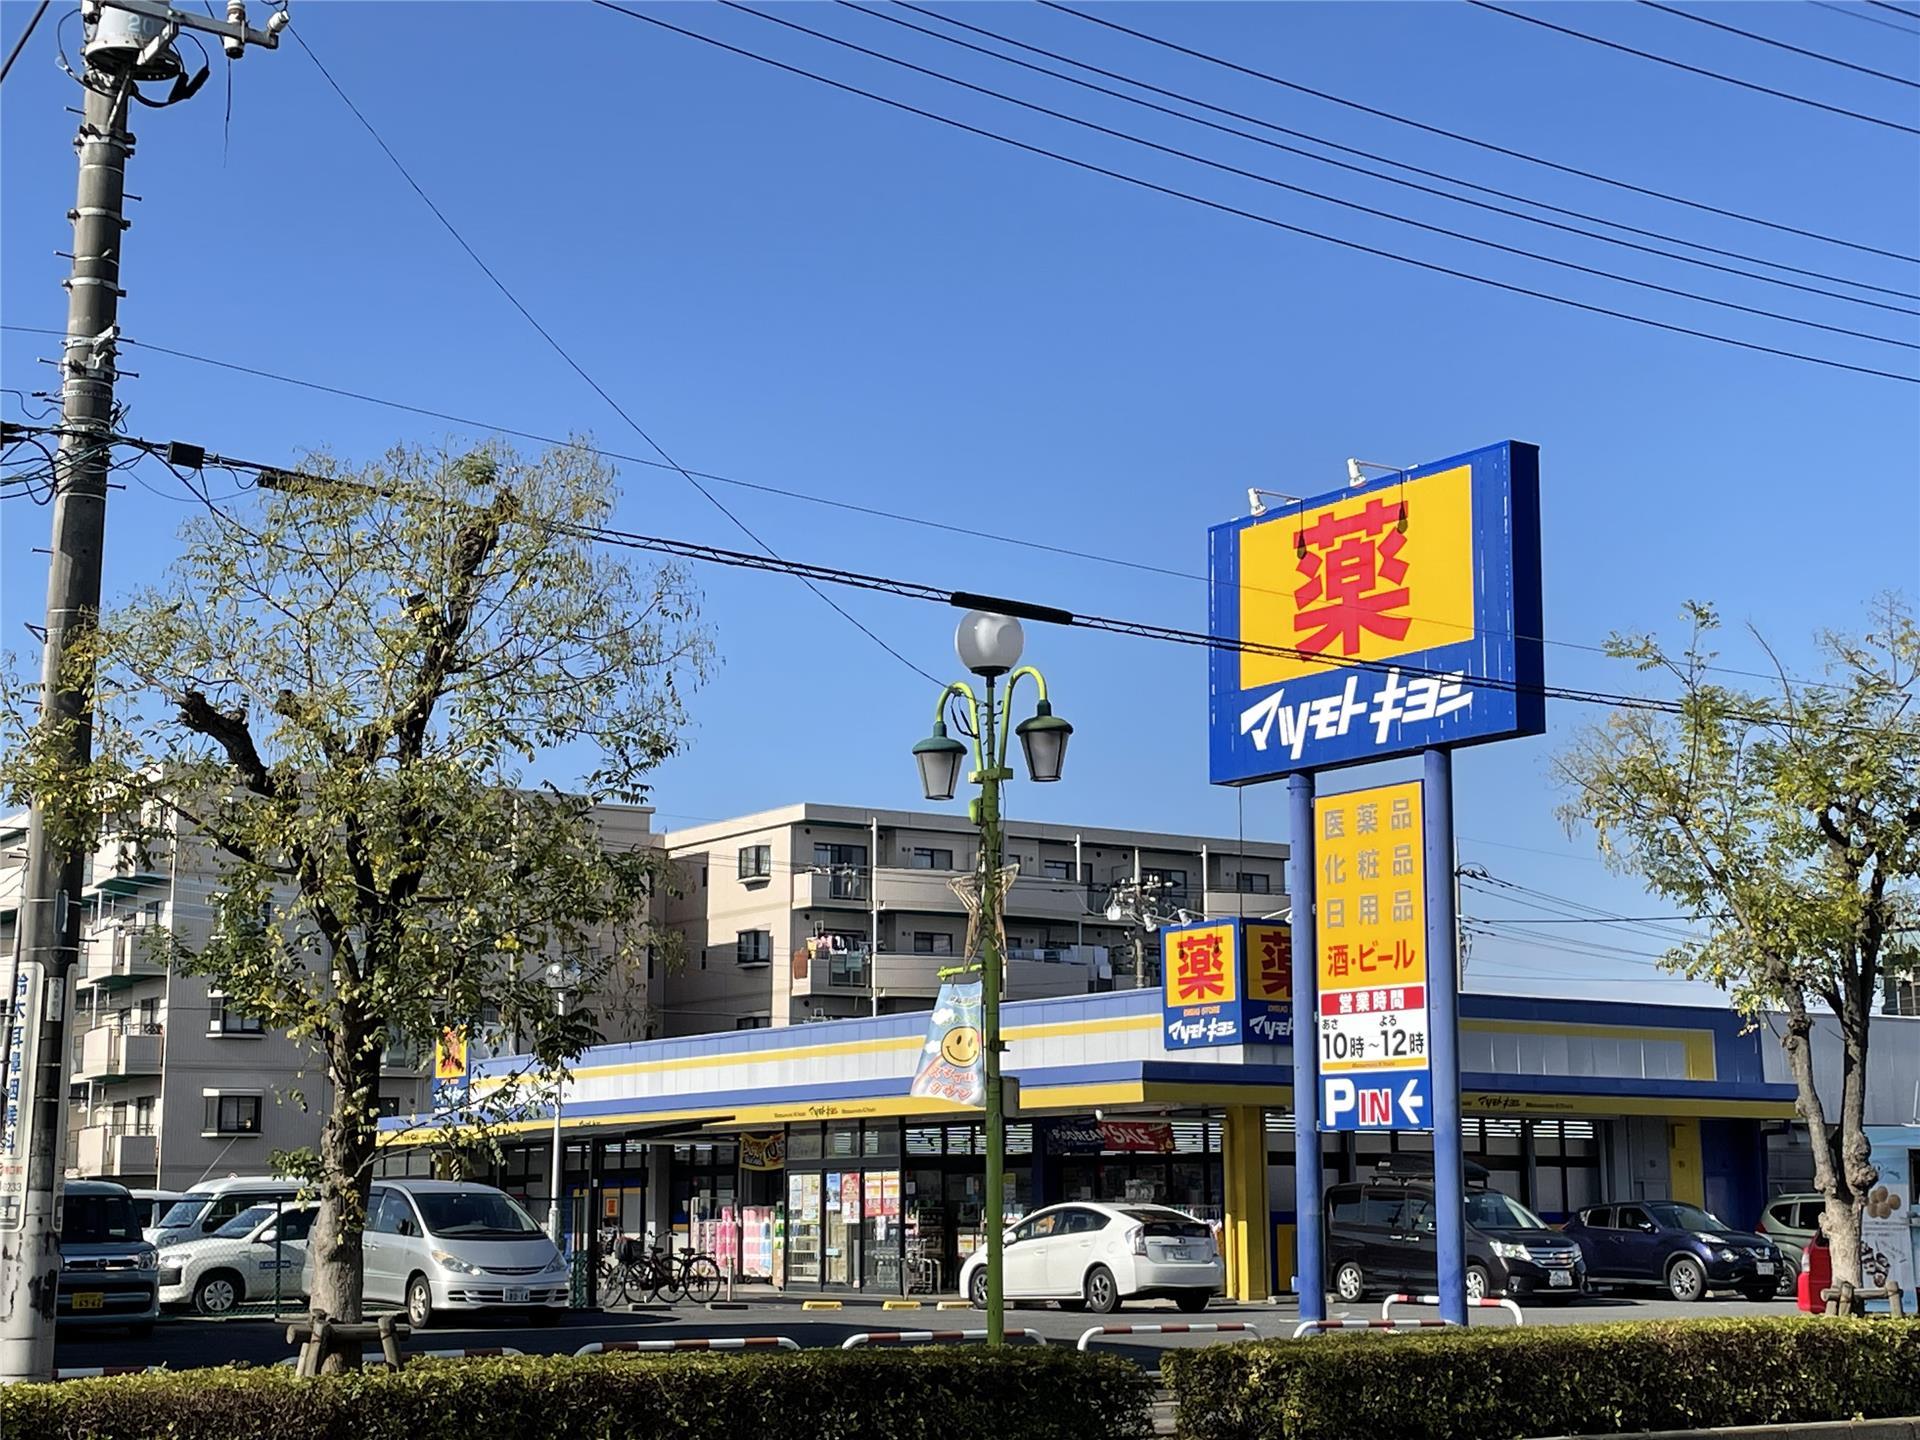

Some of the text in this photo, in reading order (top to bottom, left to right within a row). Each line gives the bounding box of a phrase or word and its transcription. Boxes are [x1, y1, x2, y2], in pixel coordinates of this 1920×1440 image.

[1293, 499, 1412, 661] 薬
[1240, 667, 1474, 760] マツモトキヨシ
[1324, 798, 1412, 841] 医薬品
[1325, 844, 1414, 885] 化粧品
[1326, 889, 1414, 929] 日用品
[1177, 933, 1225, 1000] 薬
[1322, 1015, 1397, 1030] あさ よる
[1339, 989, 1405, 1014] 営業時間
[1168, 1017, 1237, 1044] マツモトキヨシ
[1325, 1079, 1392, 1127] P IN
